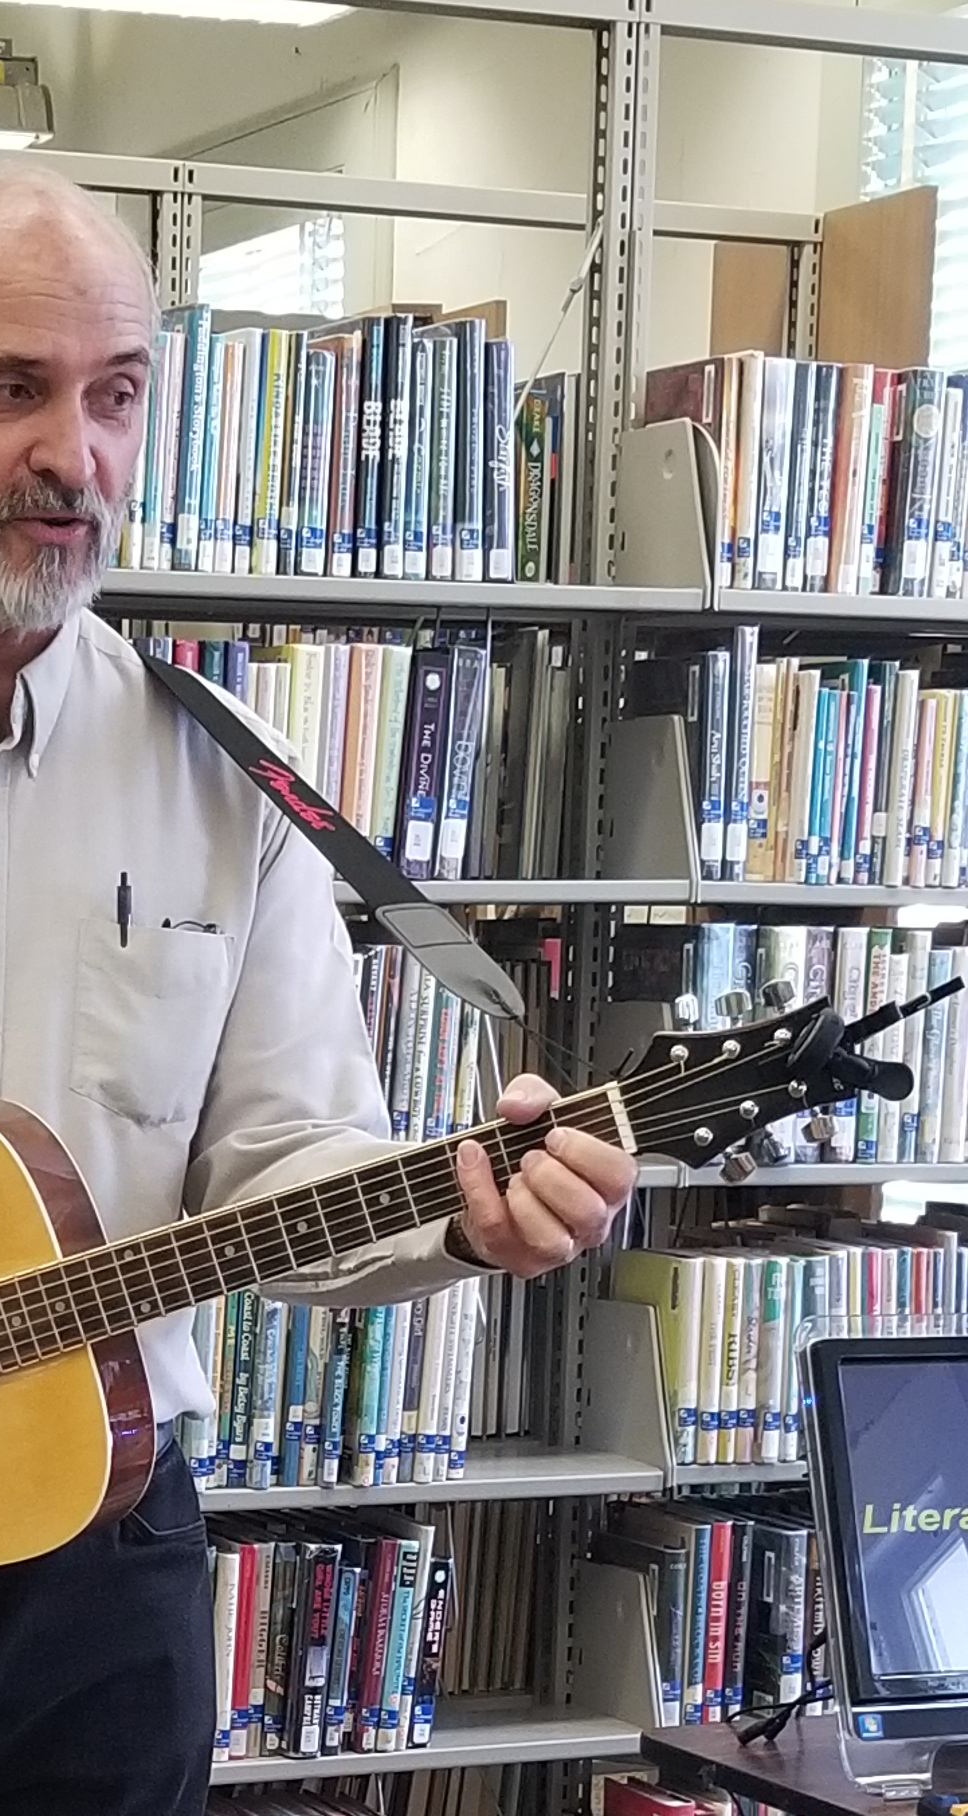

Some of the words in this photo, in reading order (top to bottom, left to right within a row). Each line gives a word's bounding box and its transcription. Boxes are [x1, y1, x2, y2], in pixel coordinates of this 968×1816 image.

[361, 400, 382, 462] BLADE
[523, 462, 542, 553] DRAGONSDALE
[247, 759, 338, 831] Fender
[242, 1292, 255, 1319] Coast
[241, 1320, 253, 1331] to
[240, 1333, 252, 1361] Coast
[237, 1372, 249, 1384] by
[235, 1386, 248, 1414] Betsy
[233, 1416, 247, 1443] Byars
